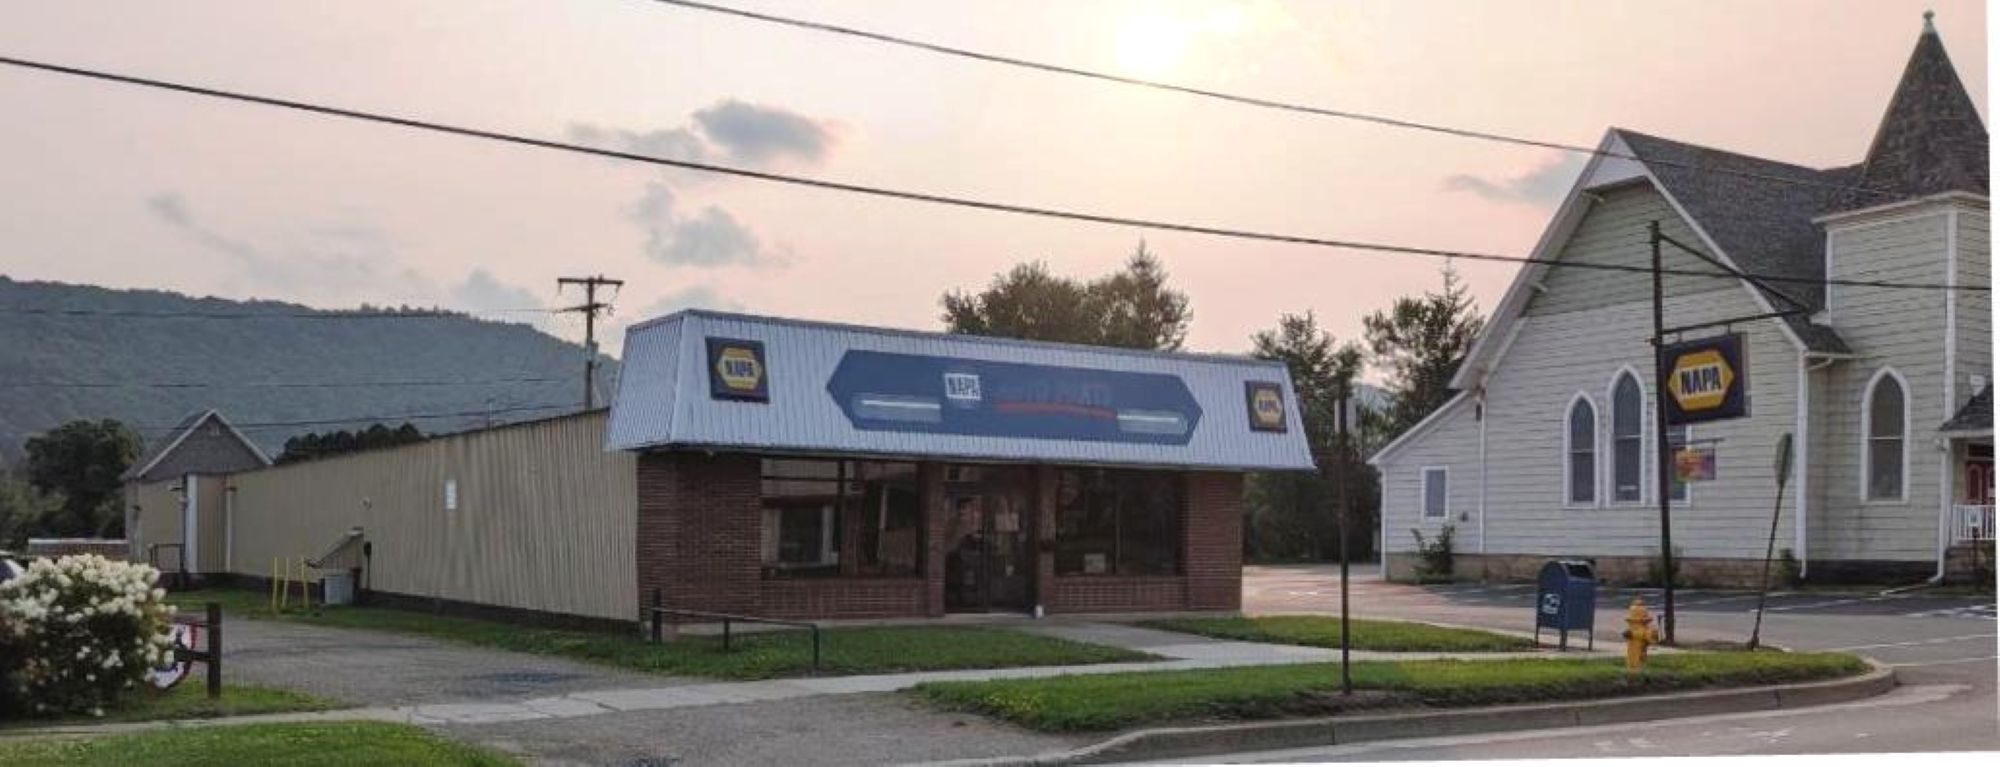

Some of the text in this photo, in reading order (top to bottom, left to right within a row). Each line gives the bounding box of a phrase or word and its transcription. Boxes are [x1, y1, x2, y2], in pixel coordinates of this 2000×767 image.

[724, 360, 755, 379] NAPA
[948, 376, 979, 398] NAPA
[1681, 366, 1721, 396] NAPA
